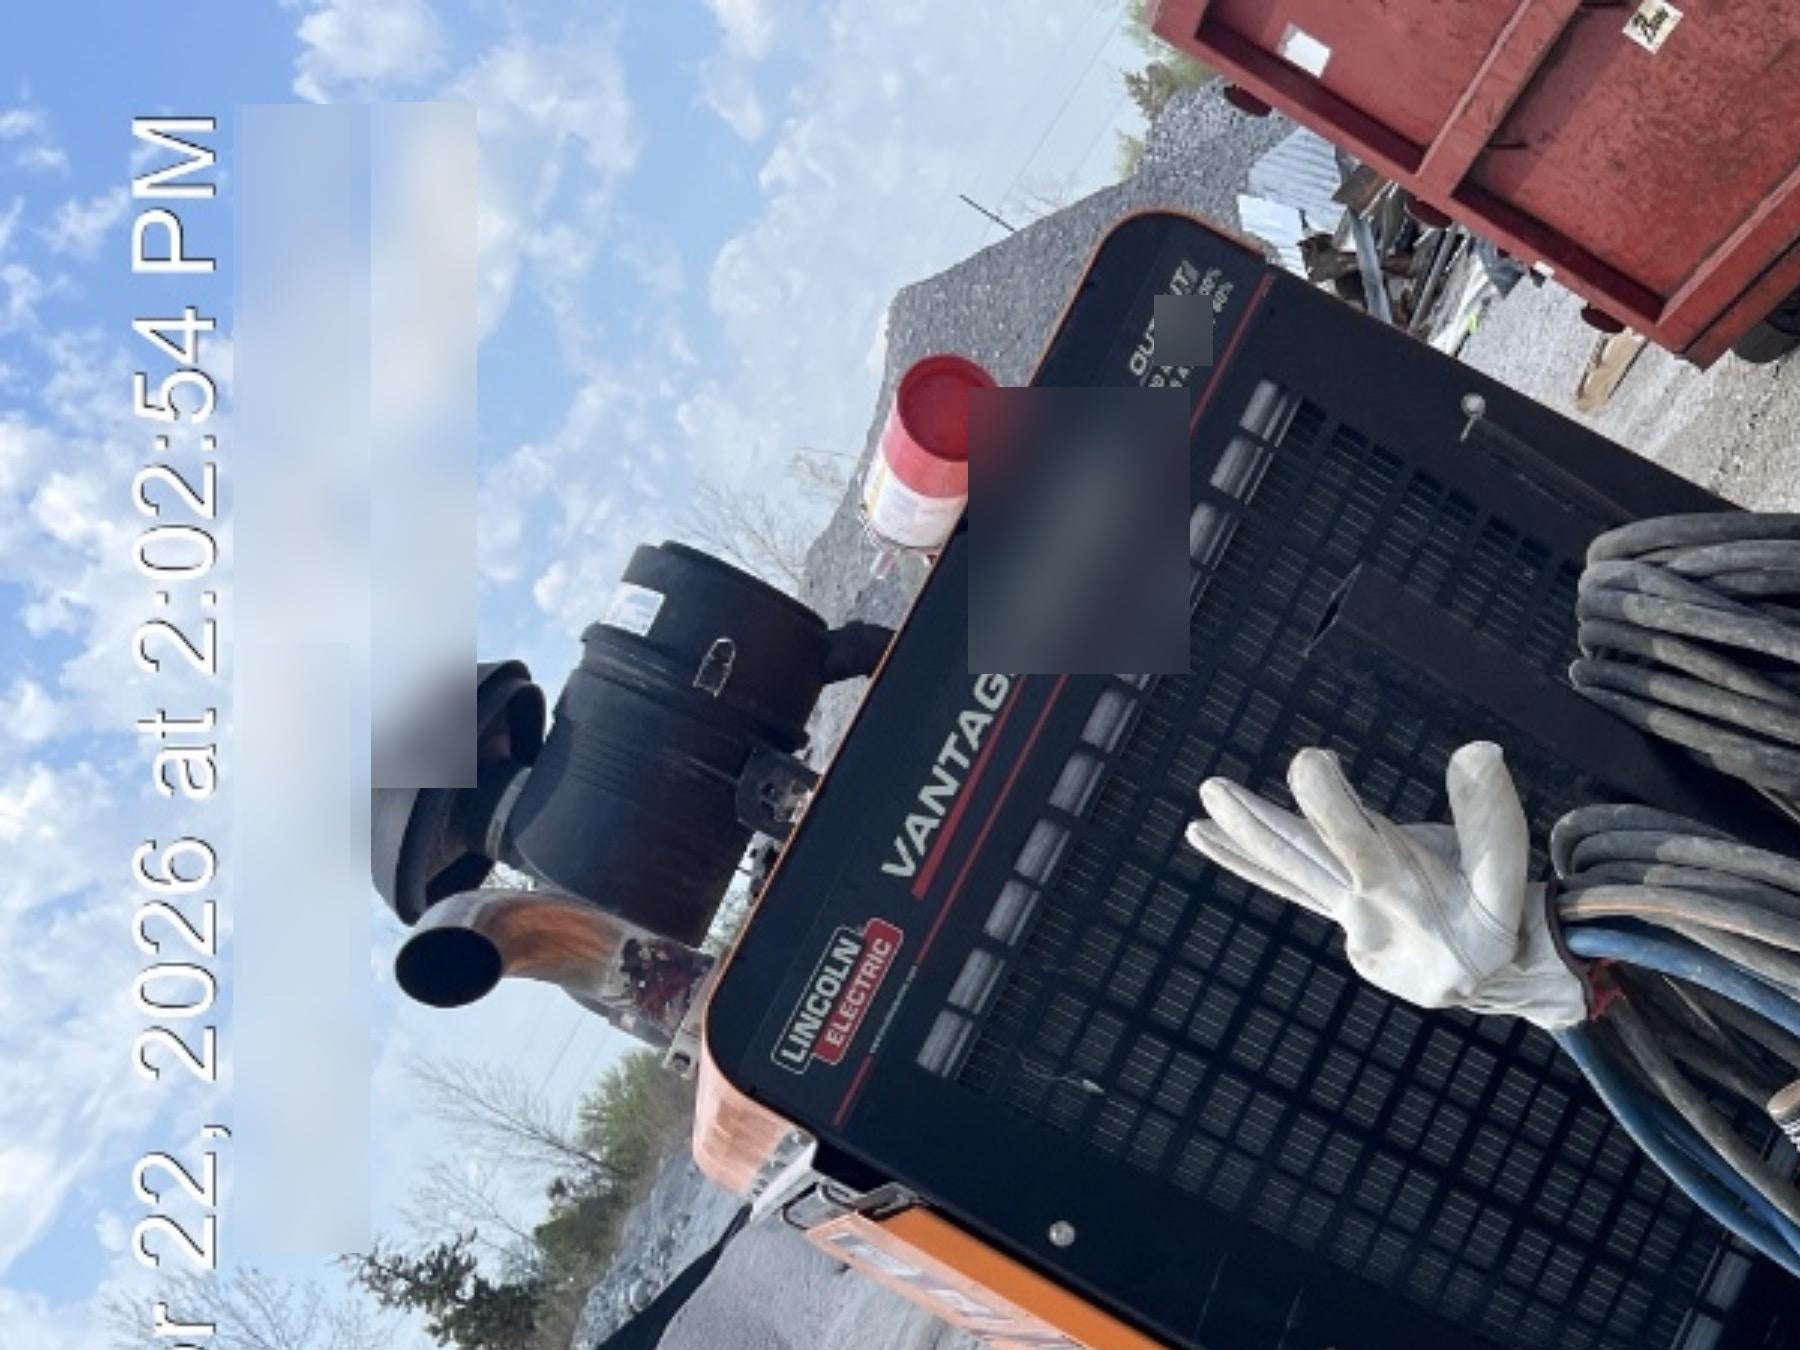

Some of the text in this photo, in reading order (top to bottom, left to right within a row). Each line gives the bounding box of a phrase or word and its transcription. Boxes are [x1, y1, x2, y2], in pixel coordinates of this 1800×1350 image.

[880, 673, 1012, 877] VANTAG
[780, 937, 862, 1063] LINCOLN
[825, 938, 892, 1047] ELECTRIC
